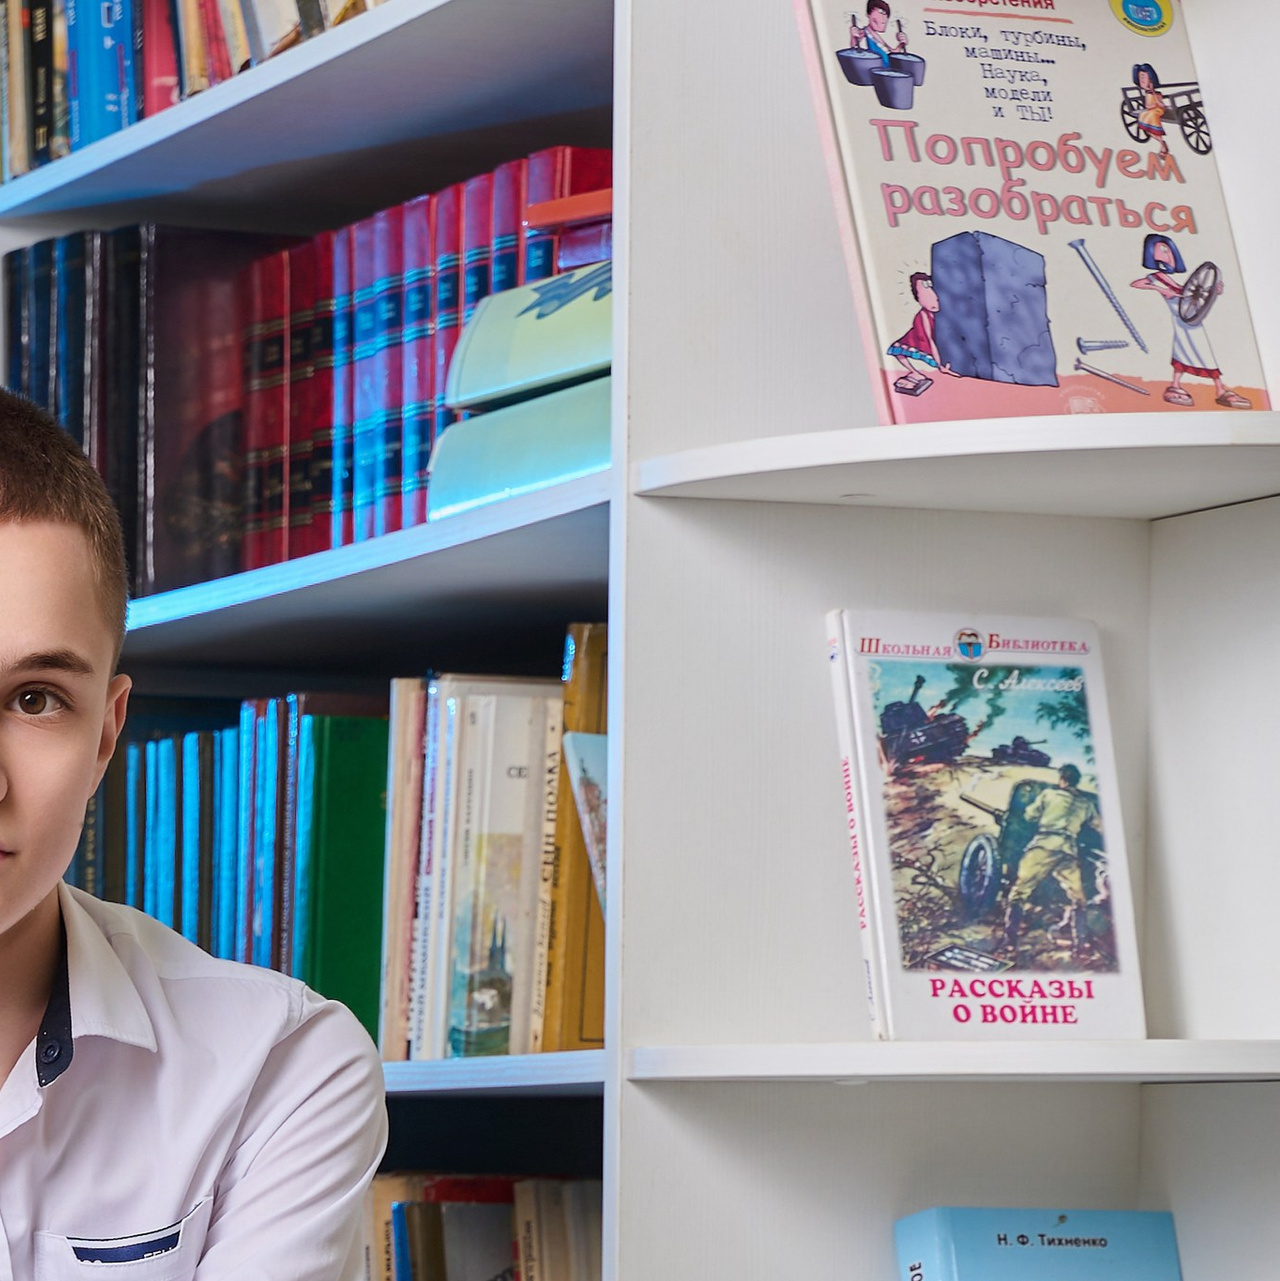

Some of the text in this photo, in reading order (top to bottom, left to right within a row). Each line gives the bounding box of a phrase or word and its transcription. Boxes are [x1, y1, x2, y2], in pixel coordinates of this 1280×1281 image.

[923, 20, 1087, 51] Блоки, турбины,
[964, 46, 1056, 65] машины...
[979, 63, 1048, 86] Наука,
[984, 86, 1053, 102] модели
[993, 104, 1054, 123] и ТЫ!
[870, 118, 1186, 188] Попробуем
[880, 179, 1198, 236] разобраться
[972, 667, 1085, 693] С. Алексеев
[841, 756, 868, 931] РАССКАЗЫ О ВОЙНЕ
[930, 978, 1095, 1000] РАССКАЗЫ
[952, 999, 1080, 1025] О ВОЙНЕ
[997, 1233, 1109, 1249] Н. Ф. Тихненко
